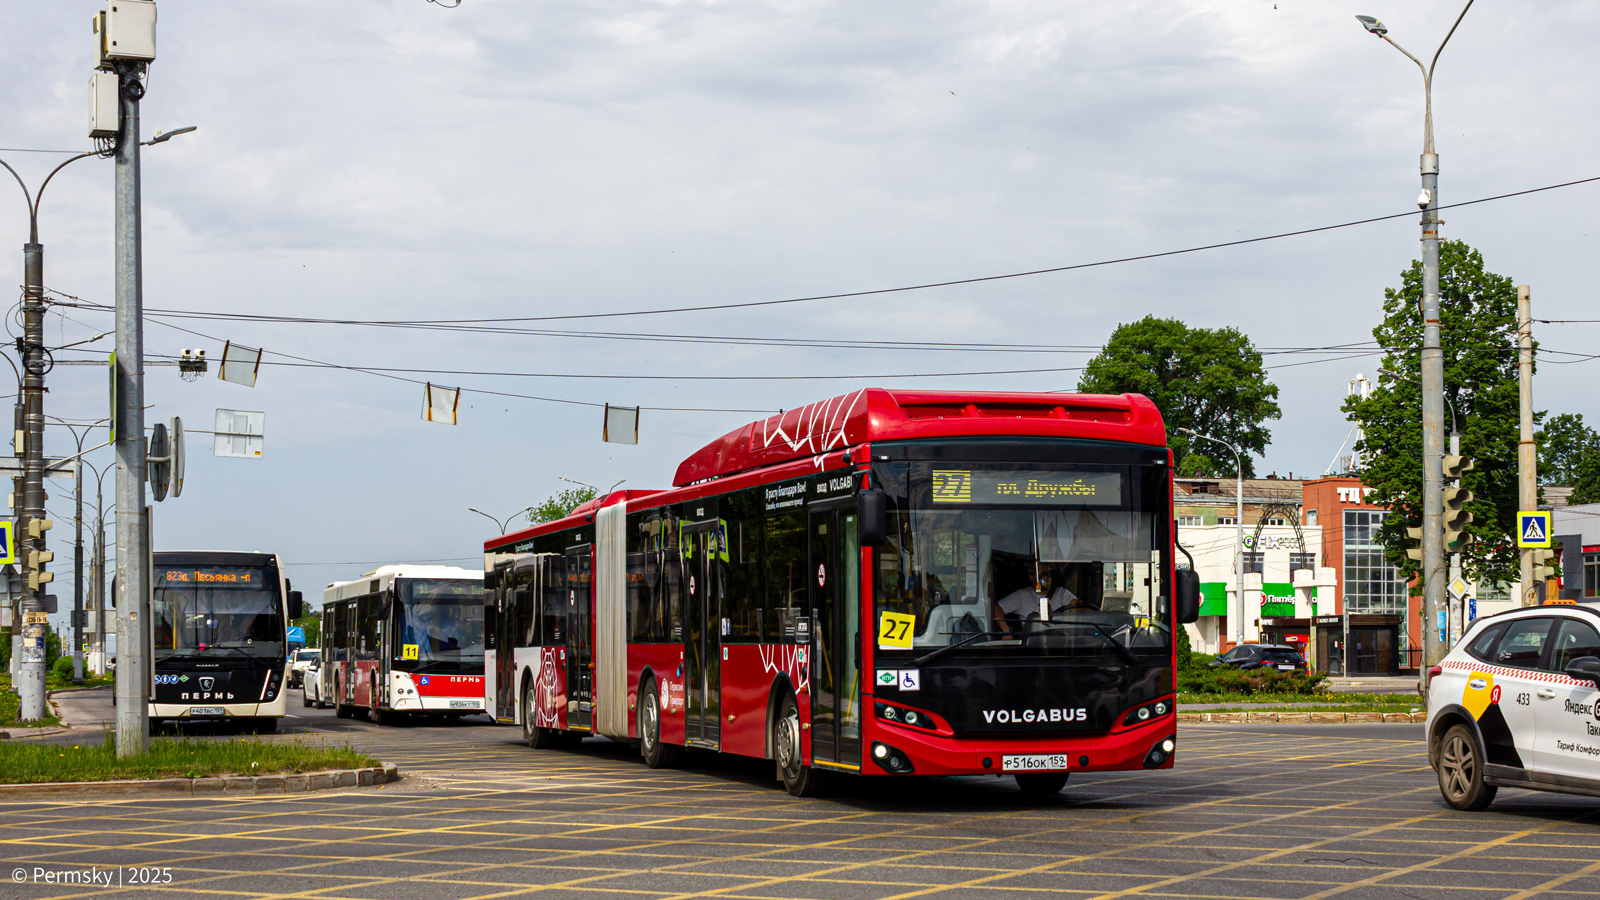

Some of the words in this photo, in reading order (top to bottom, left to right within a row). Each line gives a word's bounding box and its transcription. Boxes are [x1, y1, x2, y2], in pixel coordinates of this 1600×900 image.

[936, 474, 965, 496] 27
[1025, 479, 1096, 497] Дружбы
[1337, 487, 1361, 505] ТЦ
[194, 570, 237, 582] Песьянка
[882, 618, 911, 641] 27
[405, 647, 417, 657] 11
[181, 692, 235, 700] ПЕРМЬ
[1491, 688, 1500, 702] Я
[1516, 692, 1531, 706] 433
[1564, 698, 1593, 716] Яндекс
[982, 707, 1088, 723] VOLGABUS
[1556, 740, 1575, 752] Тариф
[1048, 756, 1065, 765] 159
